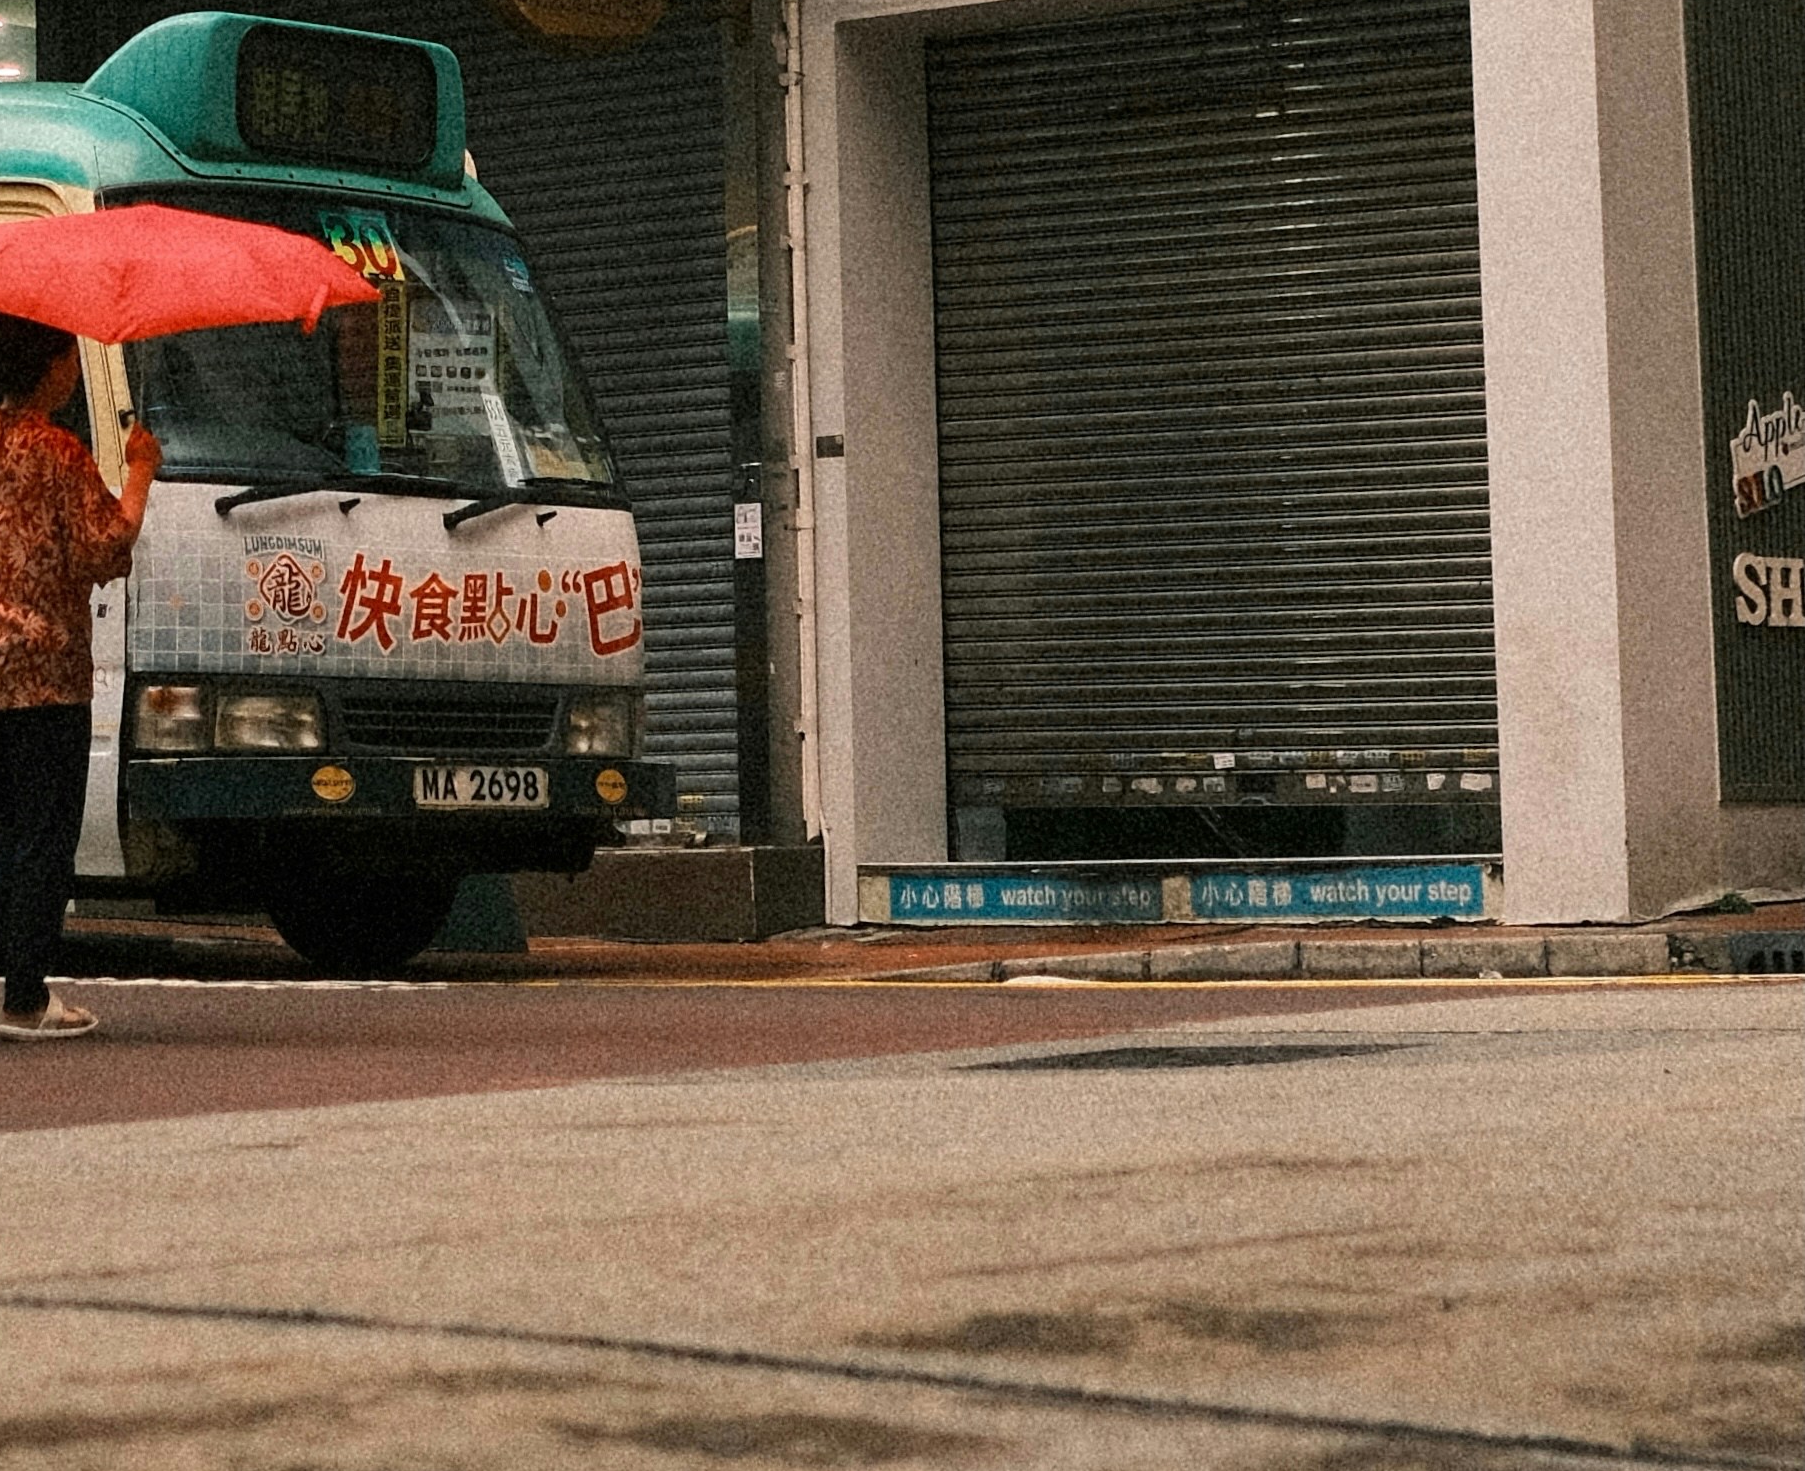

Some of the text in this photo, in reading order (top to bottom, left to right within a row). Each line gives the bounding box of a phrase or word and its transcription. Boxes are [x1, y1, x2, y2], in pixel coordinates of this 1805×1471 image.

[325, 215, 397, 276] 30
[243, 536, 324, 559] LUNGDIMSUM
[270, 560, 313, 619] 龍
[248, 629, 325, 654] 龍點心
[422, 769, 539, 802] MA 2698
[1001, 885, 1056, 907] watch
[1062, 889, 1104, 912] your
[1112, 887, 1151, 910] step
[1310, 880, 1369, 903] watch
[1375, 884, 1422, 908] your
[1428, 881, 1472, 906] step
